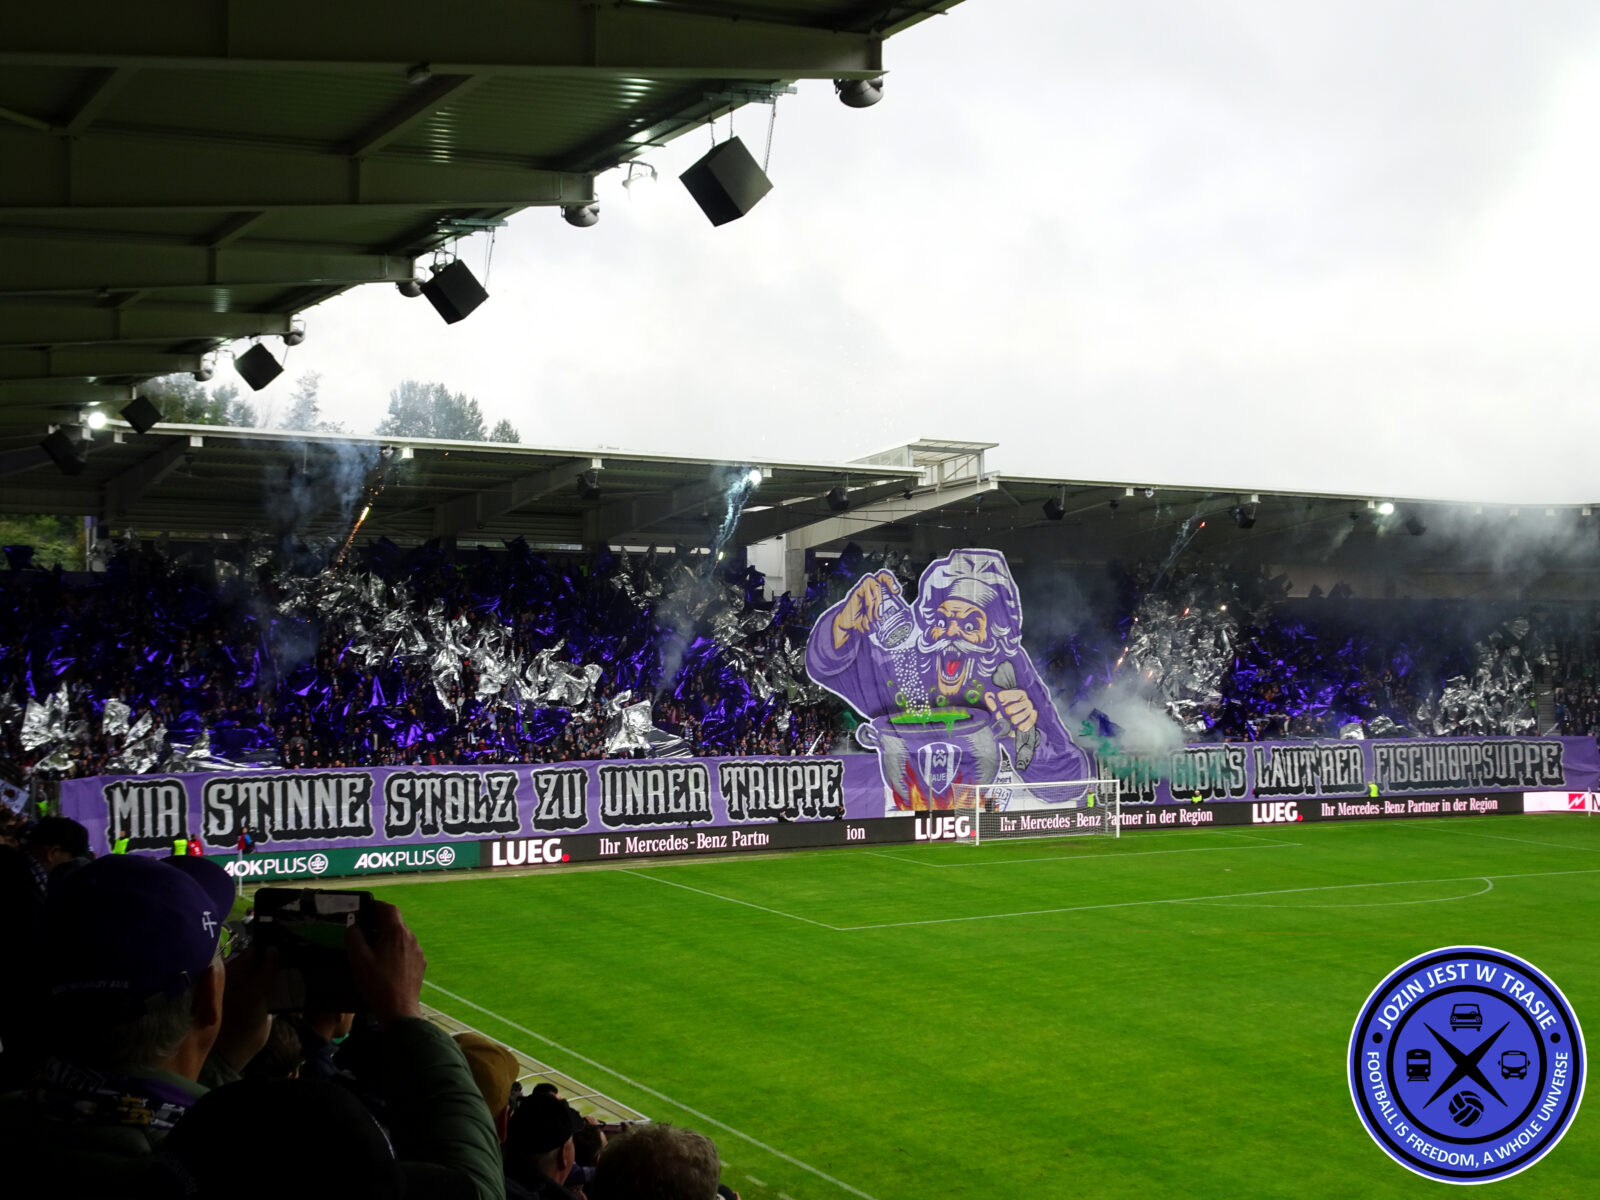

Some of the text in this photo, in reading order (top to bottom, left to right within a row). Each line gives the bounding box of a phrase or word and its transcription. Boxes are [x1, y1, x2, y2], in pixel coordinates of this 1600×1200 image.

[932, 773, 947, 782] AUE
[205, 775, 370, 842] STINNE
[387, 773, 517, 832] STOLZ
[535, 770, 585, 826] ZU
[720, 762, 843, 817] TRUPPE
[1171, 747, 1245, 796] GIBT'S
[1255, 746, 1364, 792] LAUT'RER
[1374, 743, 1564, 788] FISCHKOPPSUPPE
[1321, 797, 1497, 817] Ihr Mercedes-Benz Partner in der Region
[1000, 807, 1213, 832] Ihr Mercedes-Benz Partner in der Region
[599, 837, 621, 855] Ihr
[625, 833, 727, 854] Mercedes-Benz
